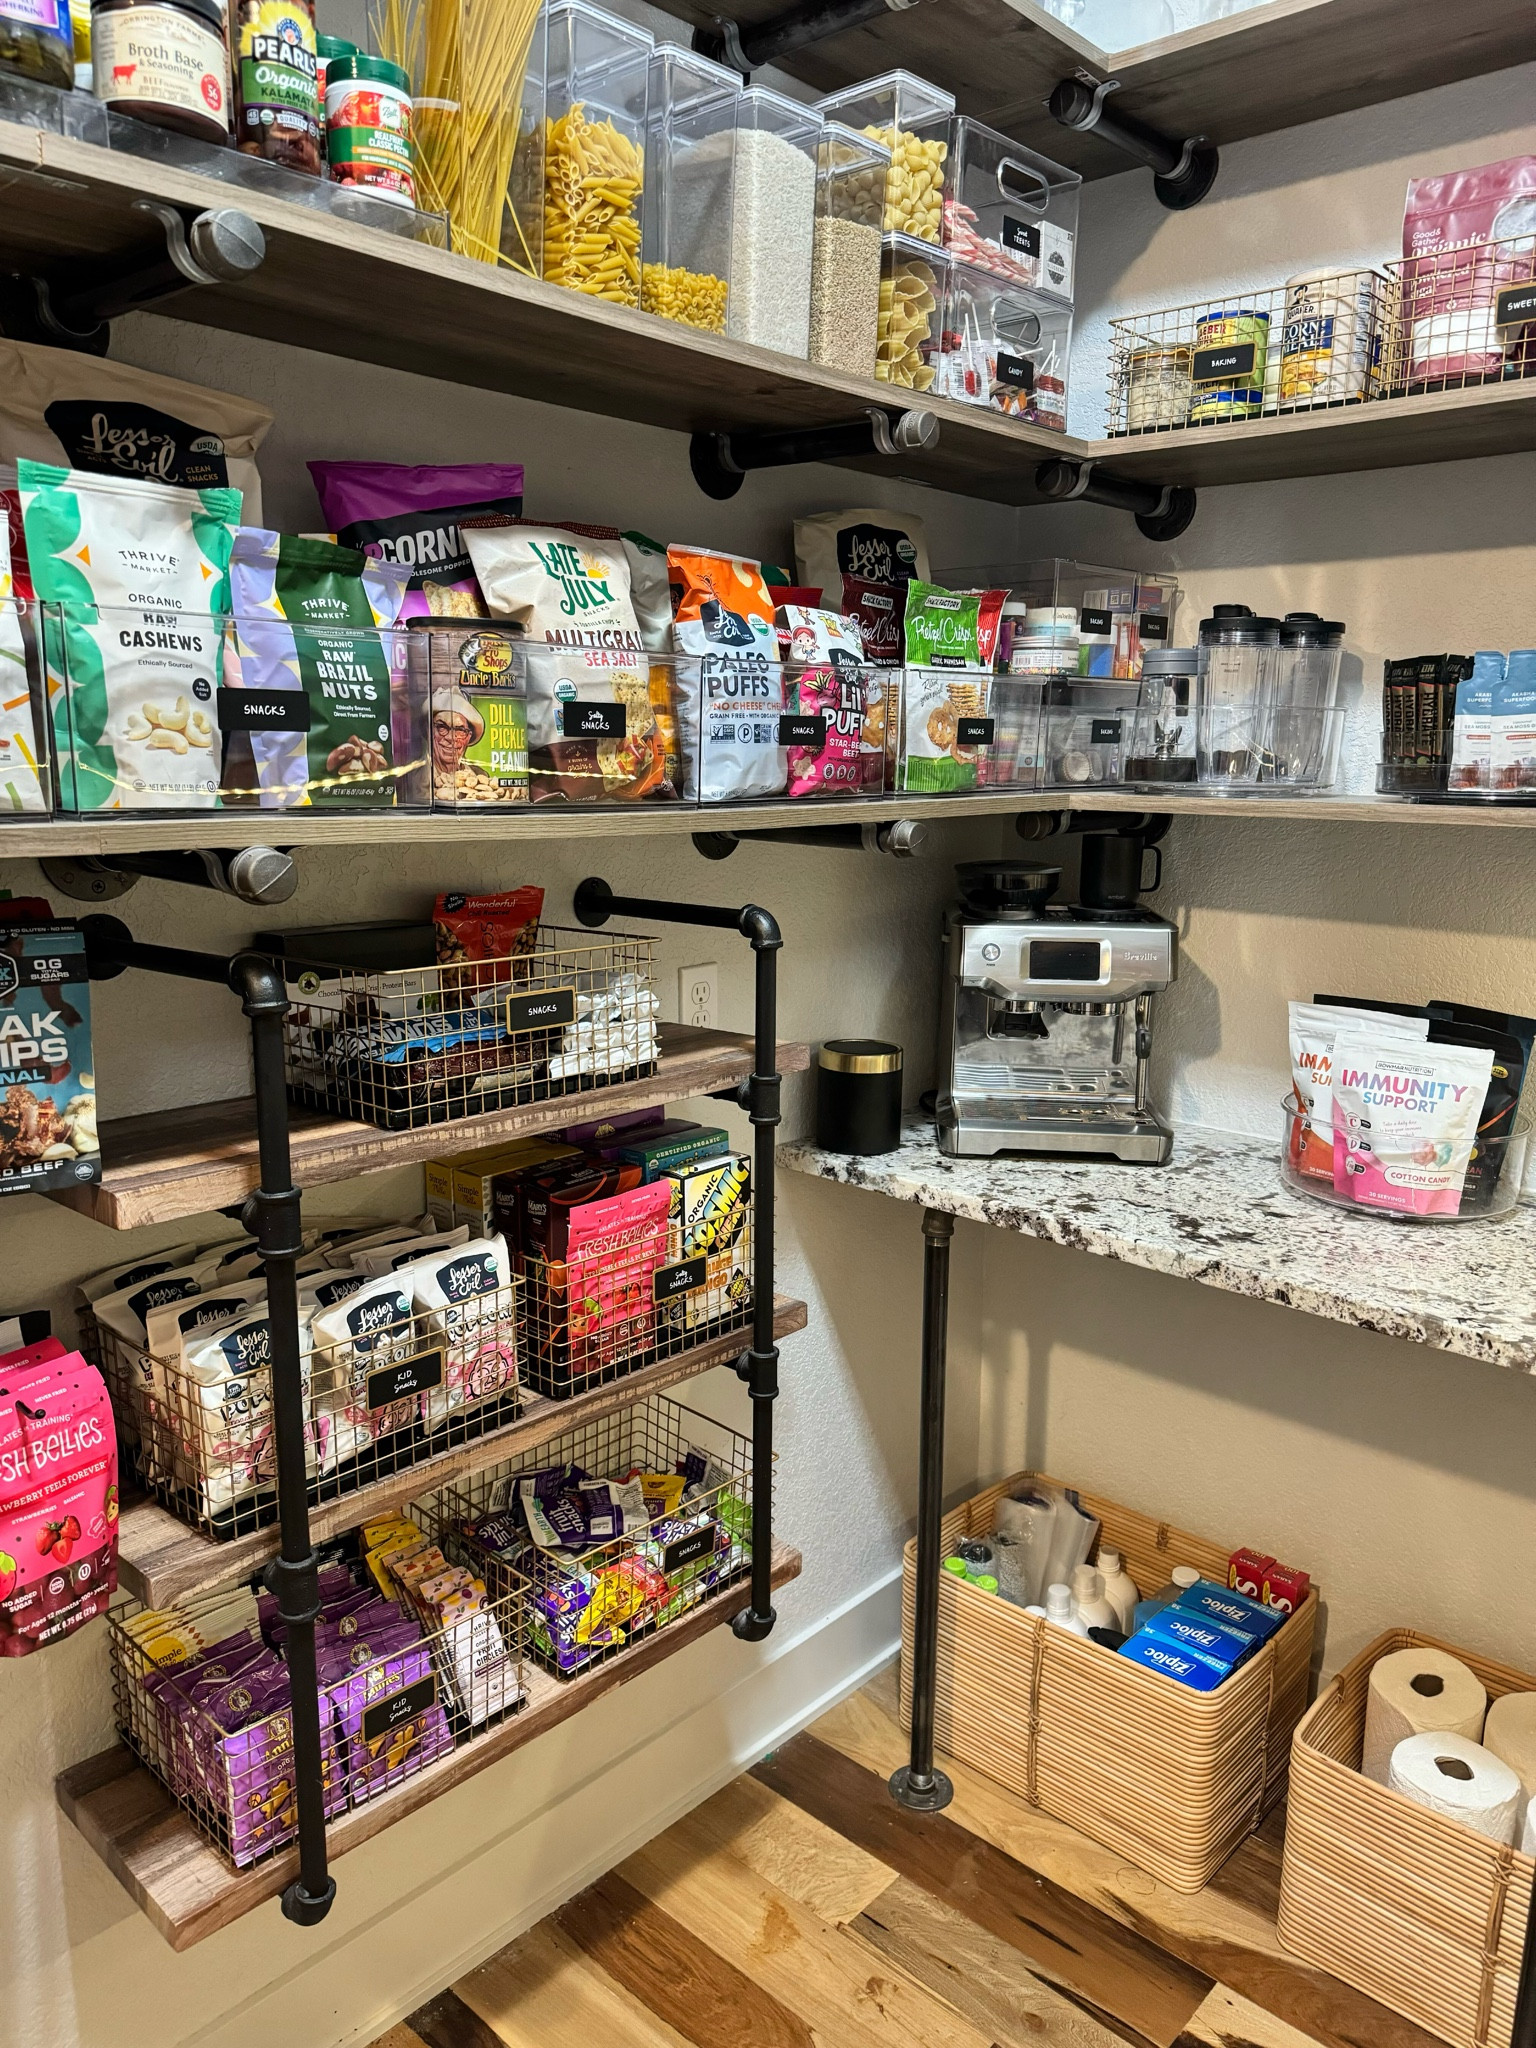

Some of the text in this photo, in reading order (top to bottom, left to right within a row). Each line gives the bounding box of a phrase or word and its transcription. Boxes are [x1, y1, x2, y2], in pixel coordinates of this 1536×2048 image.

[128, 42, 204, 72] Broth Base
[254, 38, 316, 75] PEARLS
[146, 59, 194, 79] Seasoning
[207, 85, 218, 100] 56
[255, 66, 318, 100] Organic
[279, 115, 307, 130] QUALITY
[368, 138, 392, 151] CLASSIC
[1412, 237, 1440, 248] Gather
[1412, 232, 1487, 261] organic
[1211, 357, 1237, 367] BAKING
[196, 441, 218, 452] USDA
[111, 441, 179, 483] Evil
[185, 465, 211, 474] CLEAN
[188, 473, 218, 483] SNACKS
[118, 550, 177, 567] THRIVE
[527, 541, 587, 580] LATE
[848, 535, 892, 571] Lesser
[131, 563, 171, 575] MARKET
[443, 558, 472, 571] POPPED
[863, 554, 895, 582] Evil
[128, 593, 182, 609] ORGANIC
[301, 598, 349, 611] THRIVE
[560, 575, 616, 616] JULY
[311, 612, 345, 620] MARKET
[583, 606, 610, 617] SNACKS
[119, 630, 203, 652] CASHEWS
[545, 629, 644, 653] MULTIGRAI
[911, 615, 943, 651] Pretzel
[318, 639, 354, 649] ORGANIC
[137, 658, 193, 669] Ethically Sourced
[322, 649, 354, 663] RAW
[483, 656, 508, 671] Shops
[584, 651, 637, 667] SEA SALT
[705, 652, 770, 674] PALEO
[316, 661, 374, 682] BRAZIL
[460, 670, 489, 687] Uncle
[321, 682, 378, 701] NUTS
[706, 676, 770, 698] PUFFS
[243, 704, 286, 716] SNACKS
[489, 703, 515, 727] DILL
[581, 721, 610, 730] SNACKS
[1420, 692, 1435, 748] HYDRATE
[490, 728, 525, 749] PICKLE
[792, 726, 815, 735] SNACKS
[829, 738, 862, 750] STAR-BE
[843, 748, 859, 758] BEET
[491, 751, 529, 773] PEANUT
[467, 898, 516, 909] Wonderful
[483, 909, 510, 917] Roasted
[30, 972, 70, 980] SUGARS
[528, 1005, 557, 1016] SNACKS
[1342, 1069, 1468, 1102] IMMUNITY
[1363, 1091, 1438, 1113] SUPPORT
[655, 1136, 721, 1159] CERTIFIED ORGANIC
[21, 1160, 64, 1174] BEEF
[1390, 1172, 1451, 1184] COTTON CANDY
[528, 1200, 547, 1212] MARY'S
[687, 1174, 719, 1224] ORGANIC
[1377, 1192, 1406, 1203] SERVINGS
[684, 1159, 750, 1258] COSMIC
[576, 1234, 619, 1261] FRESH
[449, 1262, 482, 1291] Lesser
[459, 1273, 482, 1296] Evil
[669, 1275, 693, 1290] SNACKS
[194, 1307, 231, 1328] Lesser
[358, 1302, 394, 1334] Lesser
[237, 1329, 269, 1359] Lesser
[249, 1340, 271, 1366] Evil
[14, 1359, 29, 1369] FRIED
[397, 1369, 412, 1381] KID
[34, 1387, 67, 1403] NEVER FRIED
[394, 1380, 418, 1393] Snacks
[0, 1414, 71, 1447] LATES TRAINING
[0, 1461, 106, 1513] AWBERRY FEELS FOREVER
[11, 1491, 86, 1525] STRAWBERRIES BALSAMIC
[557, 1498, 586, 1533] snacks
[548, 1509, 574, 1533] fruit
[678, 1541, 702, 1558] SNACKS
[2, 1590, 38, 1608] NO ADDED
[9, 1600, 33, 1613] SUGAR
[1201, 1596, 1247, 1621] Ziploc
[18, 1624, 30, 1634] For
[31, 1616, 47, 1629] Ages
[47, 1612, 55, 1620] 12
[39, 1628, 51, 1641] NET
[75, 1611, 83, 1621] OZ
[1170, 1621, 1216, 1647] Ziploc
[153, 1647, 183, 1666] imple
[476, 1647, 504, 1667] CIRCLES
[1144, 1647, 1190, 1674] Ziploc
[389, 1705, 412, 1722] Snacks
[392, 1697, 407, 1711] KID
